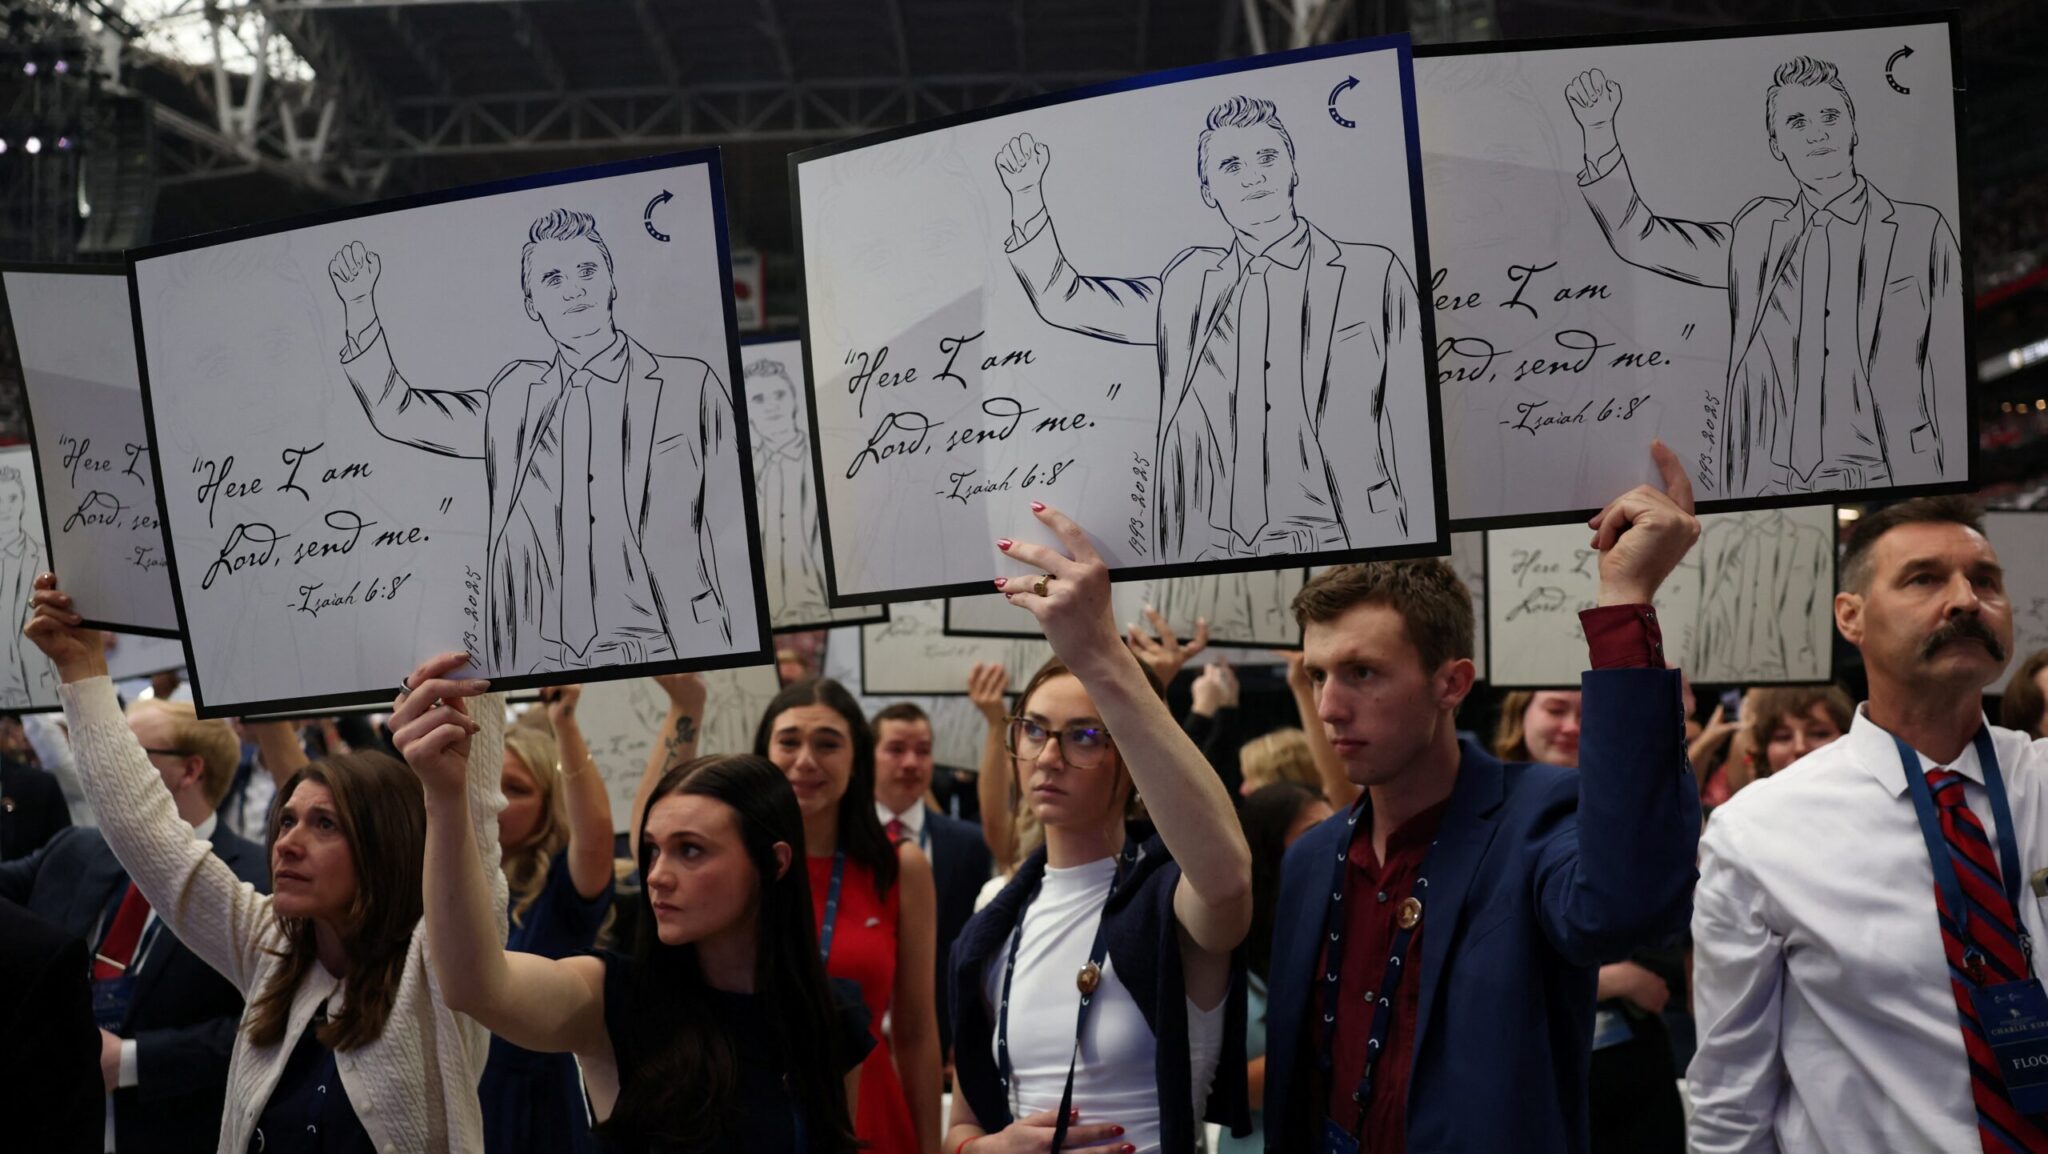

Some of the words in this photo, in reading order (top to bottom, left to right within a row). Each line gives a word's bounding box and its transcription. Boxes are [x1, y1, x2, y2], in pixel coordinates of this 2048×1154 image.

[1500, 261, 1558, 319] I
[1553, 283, 1612, 302] am
[845, 346, 917, 418] "Here
[932, 330, 985, 389] I
[980, 348, 1036, 371] am
[1514, 329, 1616, 382] send
[846, 411, 945, 480] Lord,
[946, 397, 1040, 452] send
[1500, 400, 1594, 436] -Isaiah
[1597, 395, 1651, 421] 6:8
[1698, 389, 1720, 491] 1993-2025
[59, 434, 112, 489] "Here
[121, 443, 150, 486] I
[192, 456, 263, 528] "Here
[277, 442, 324, 501] I
[322, 461, 372, 483] am
[936, 467, 1018, 505] -Isaiah
[1021, 459, 1075, 489] 6:8
[63, 490, 131, 532] Lord,
[1128, 451, 1150, 557] 1993-2025
[201, 523, 291, 590] Lord,
[294, 510, 378, 565] send
[287, 581, 361, 618] -Isaiah
[364, 573, 412, 602] 6:8
